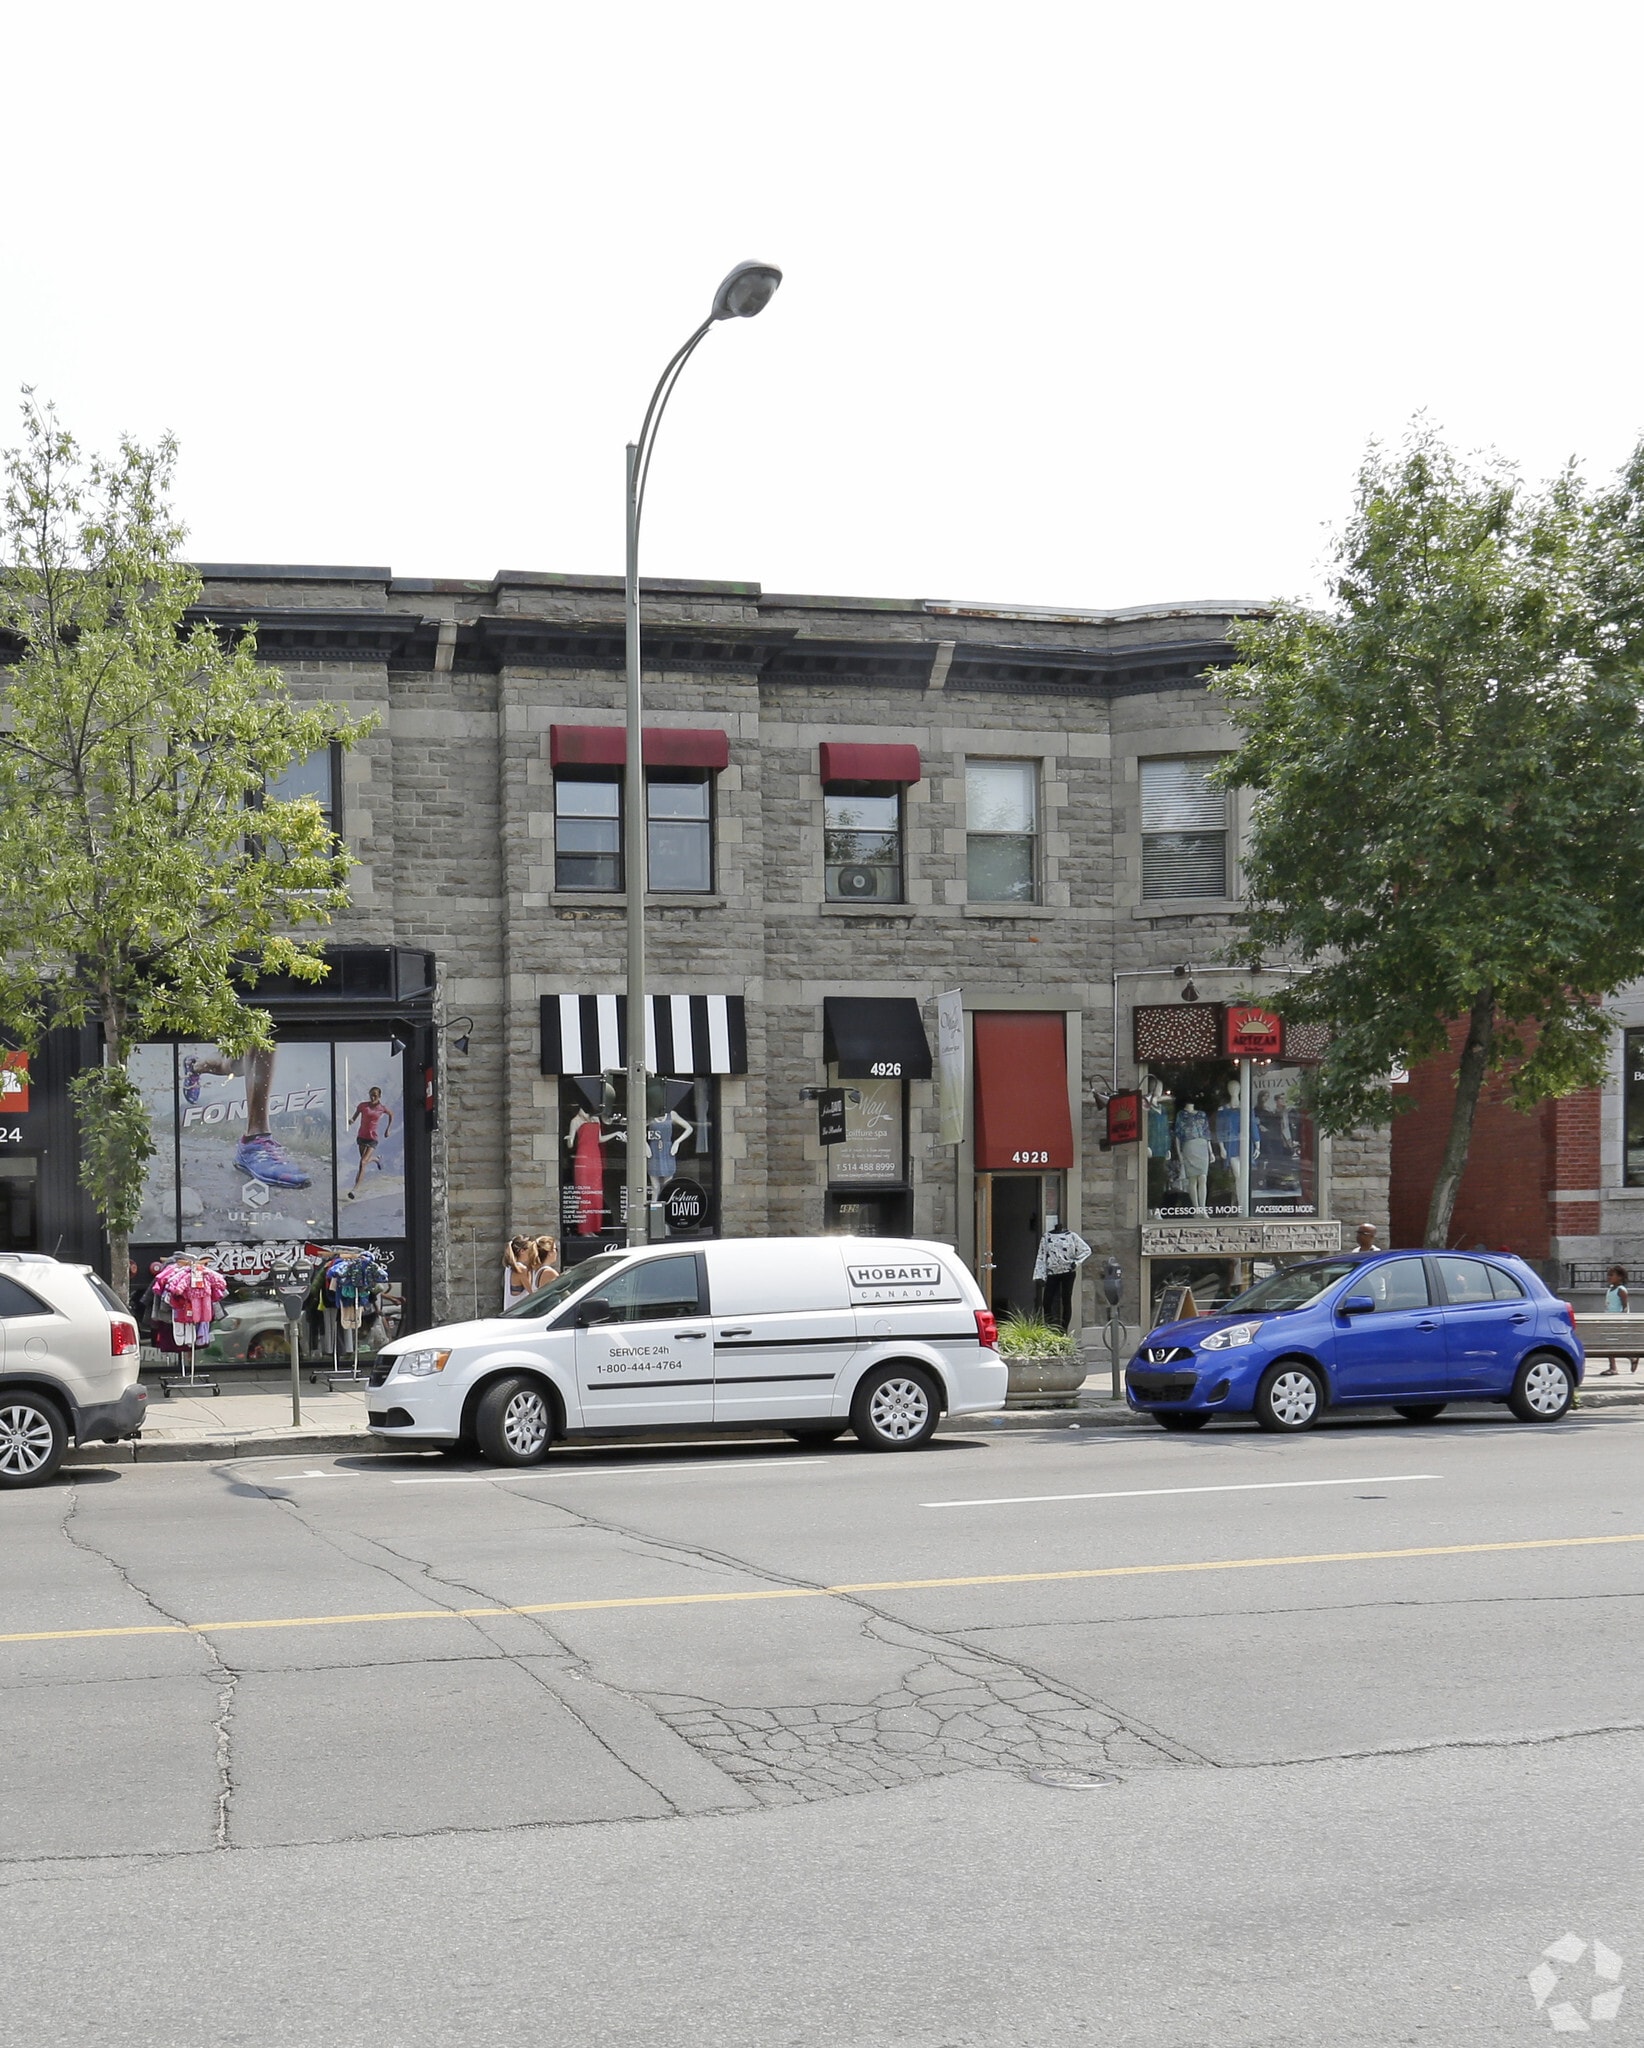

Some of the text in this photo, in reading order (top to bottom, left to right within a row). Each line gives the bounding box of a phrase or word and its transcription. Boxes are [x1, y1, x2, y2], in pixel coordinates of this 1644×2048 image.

[870, 1062, 901, 1076] 4926
[875, 1130, 887, 1138] spa
[1012, 1151, 1049, 1164] 4928
[842, 1163, 857, 1171] 514
[859, 1163, 874, 1171] 488
[875, 1162, 896, 1171] 8999
[671, 1201, 700, 1216] DAVID
[840, 1203, 860, 1213] 4926
[1154, 1205, 1243, 1216] ACCESSOIRES MODE
[1255, 1204, 1314, 1214] ACCESSOIRES MODE
[228, 1212, 284, 1221] ULTRA
[858, 1268, 932, 1280] HOBART
[861, 1289, 935, 1299] CANADA
[609, 1346, 670, 1357] SERVICE 24h
[597, 1360, 682, 1374] 1-800-444-4764
